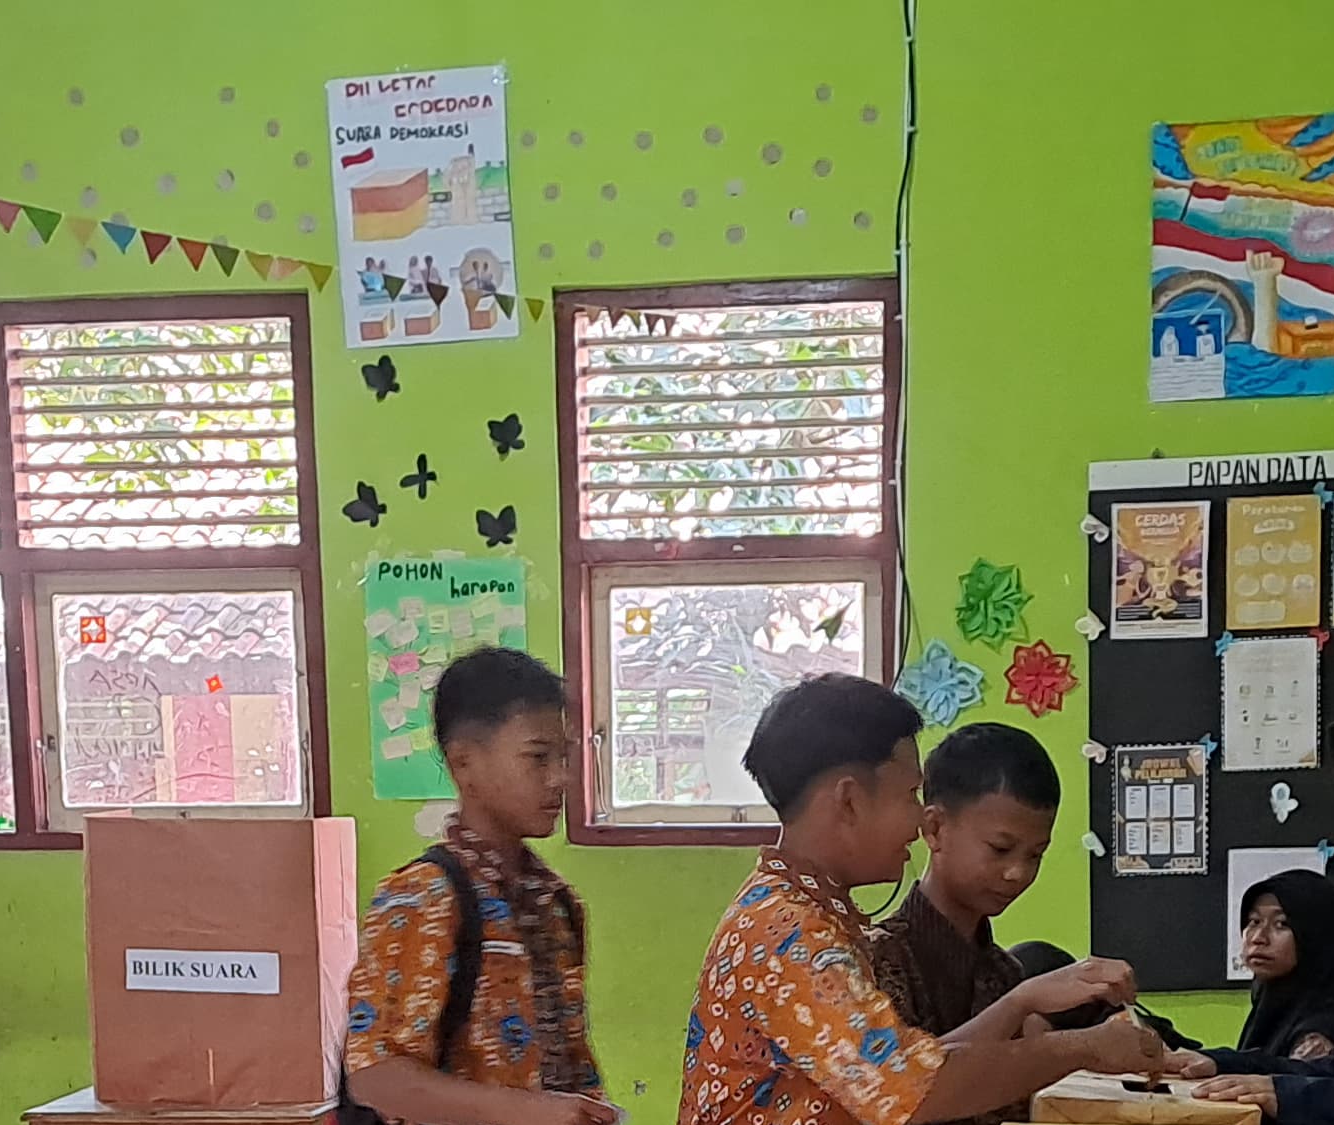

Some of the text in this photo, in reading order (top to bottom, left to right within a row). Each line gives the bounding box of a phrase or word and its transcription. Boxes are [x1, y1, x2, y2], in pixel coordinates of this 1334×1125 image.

[335, 121, 469, 145] SUARA DEMOKRASI
[1188, 455, 1327, 487] PAPAN DATA
[378, 562, 443, 581] POHON
[132, 961, 258, 979] BILIK SUARA
